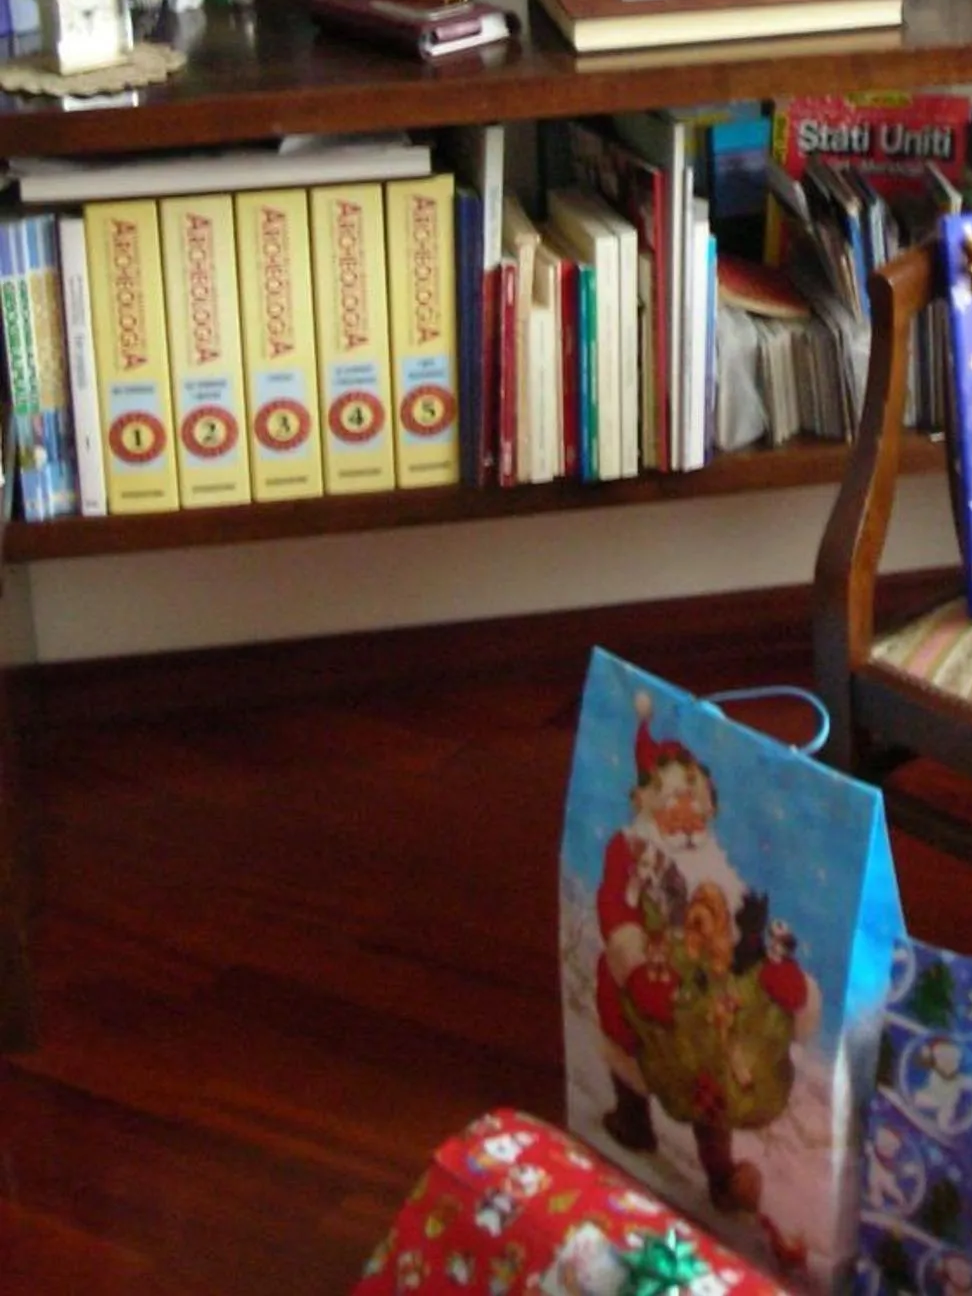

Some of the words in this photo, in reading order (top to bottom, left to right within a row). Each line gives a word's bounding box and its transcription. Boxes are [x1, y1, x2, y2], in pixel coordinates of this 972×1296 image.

[798, 118, 870, 153] Stati
[880, 122, 953, 157] Uniti
[347, 405, 365, 429] 4
[420, 397, 437, 422] 5
[133, 428, 142, 448] 1
[197, 421, 217, 446] 2
